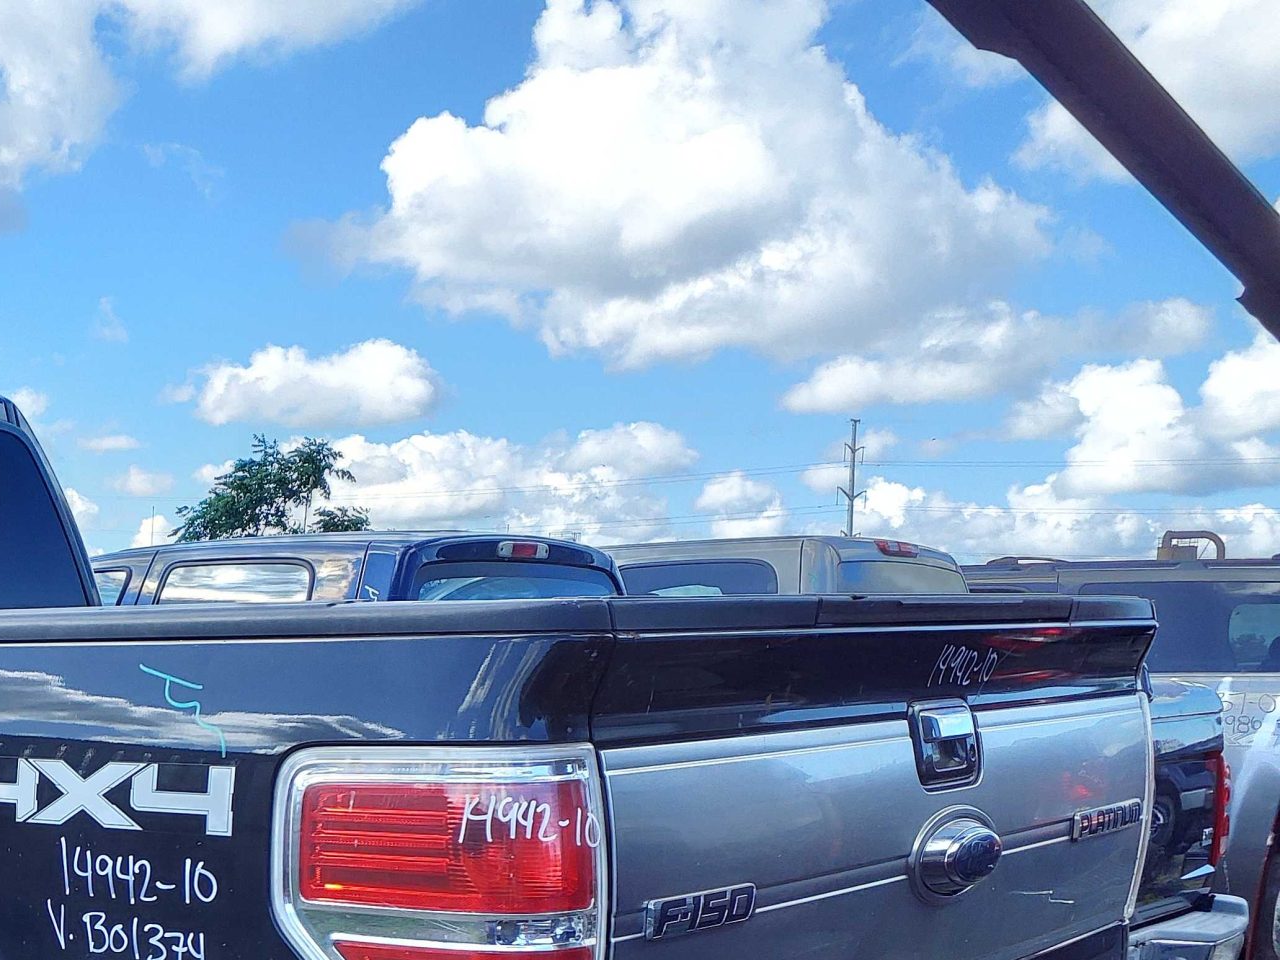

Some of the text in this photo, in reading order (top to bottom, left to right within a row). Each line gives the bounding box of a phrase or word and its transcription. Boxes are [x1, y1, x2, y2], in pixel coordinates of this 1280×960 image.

[927, 643, 998, 688] 14942-10
[458, 793, 601, 848] 14942-10
[1077, 799, 1141, 839] PLATINUM
[60, 836, 218, 905] 14942-10
